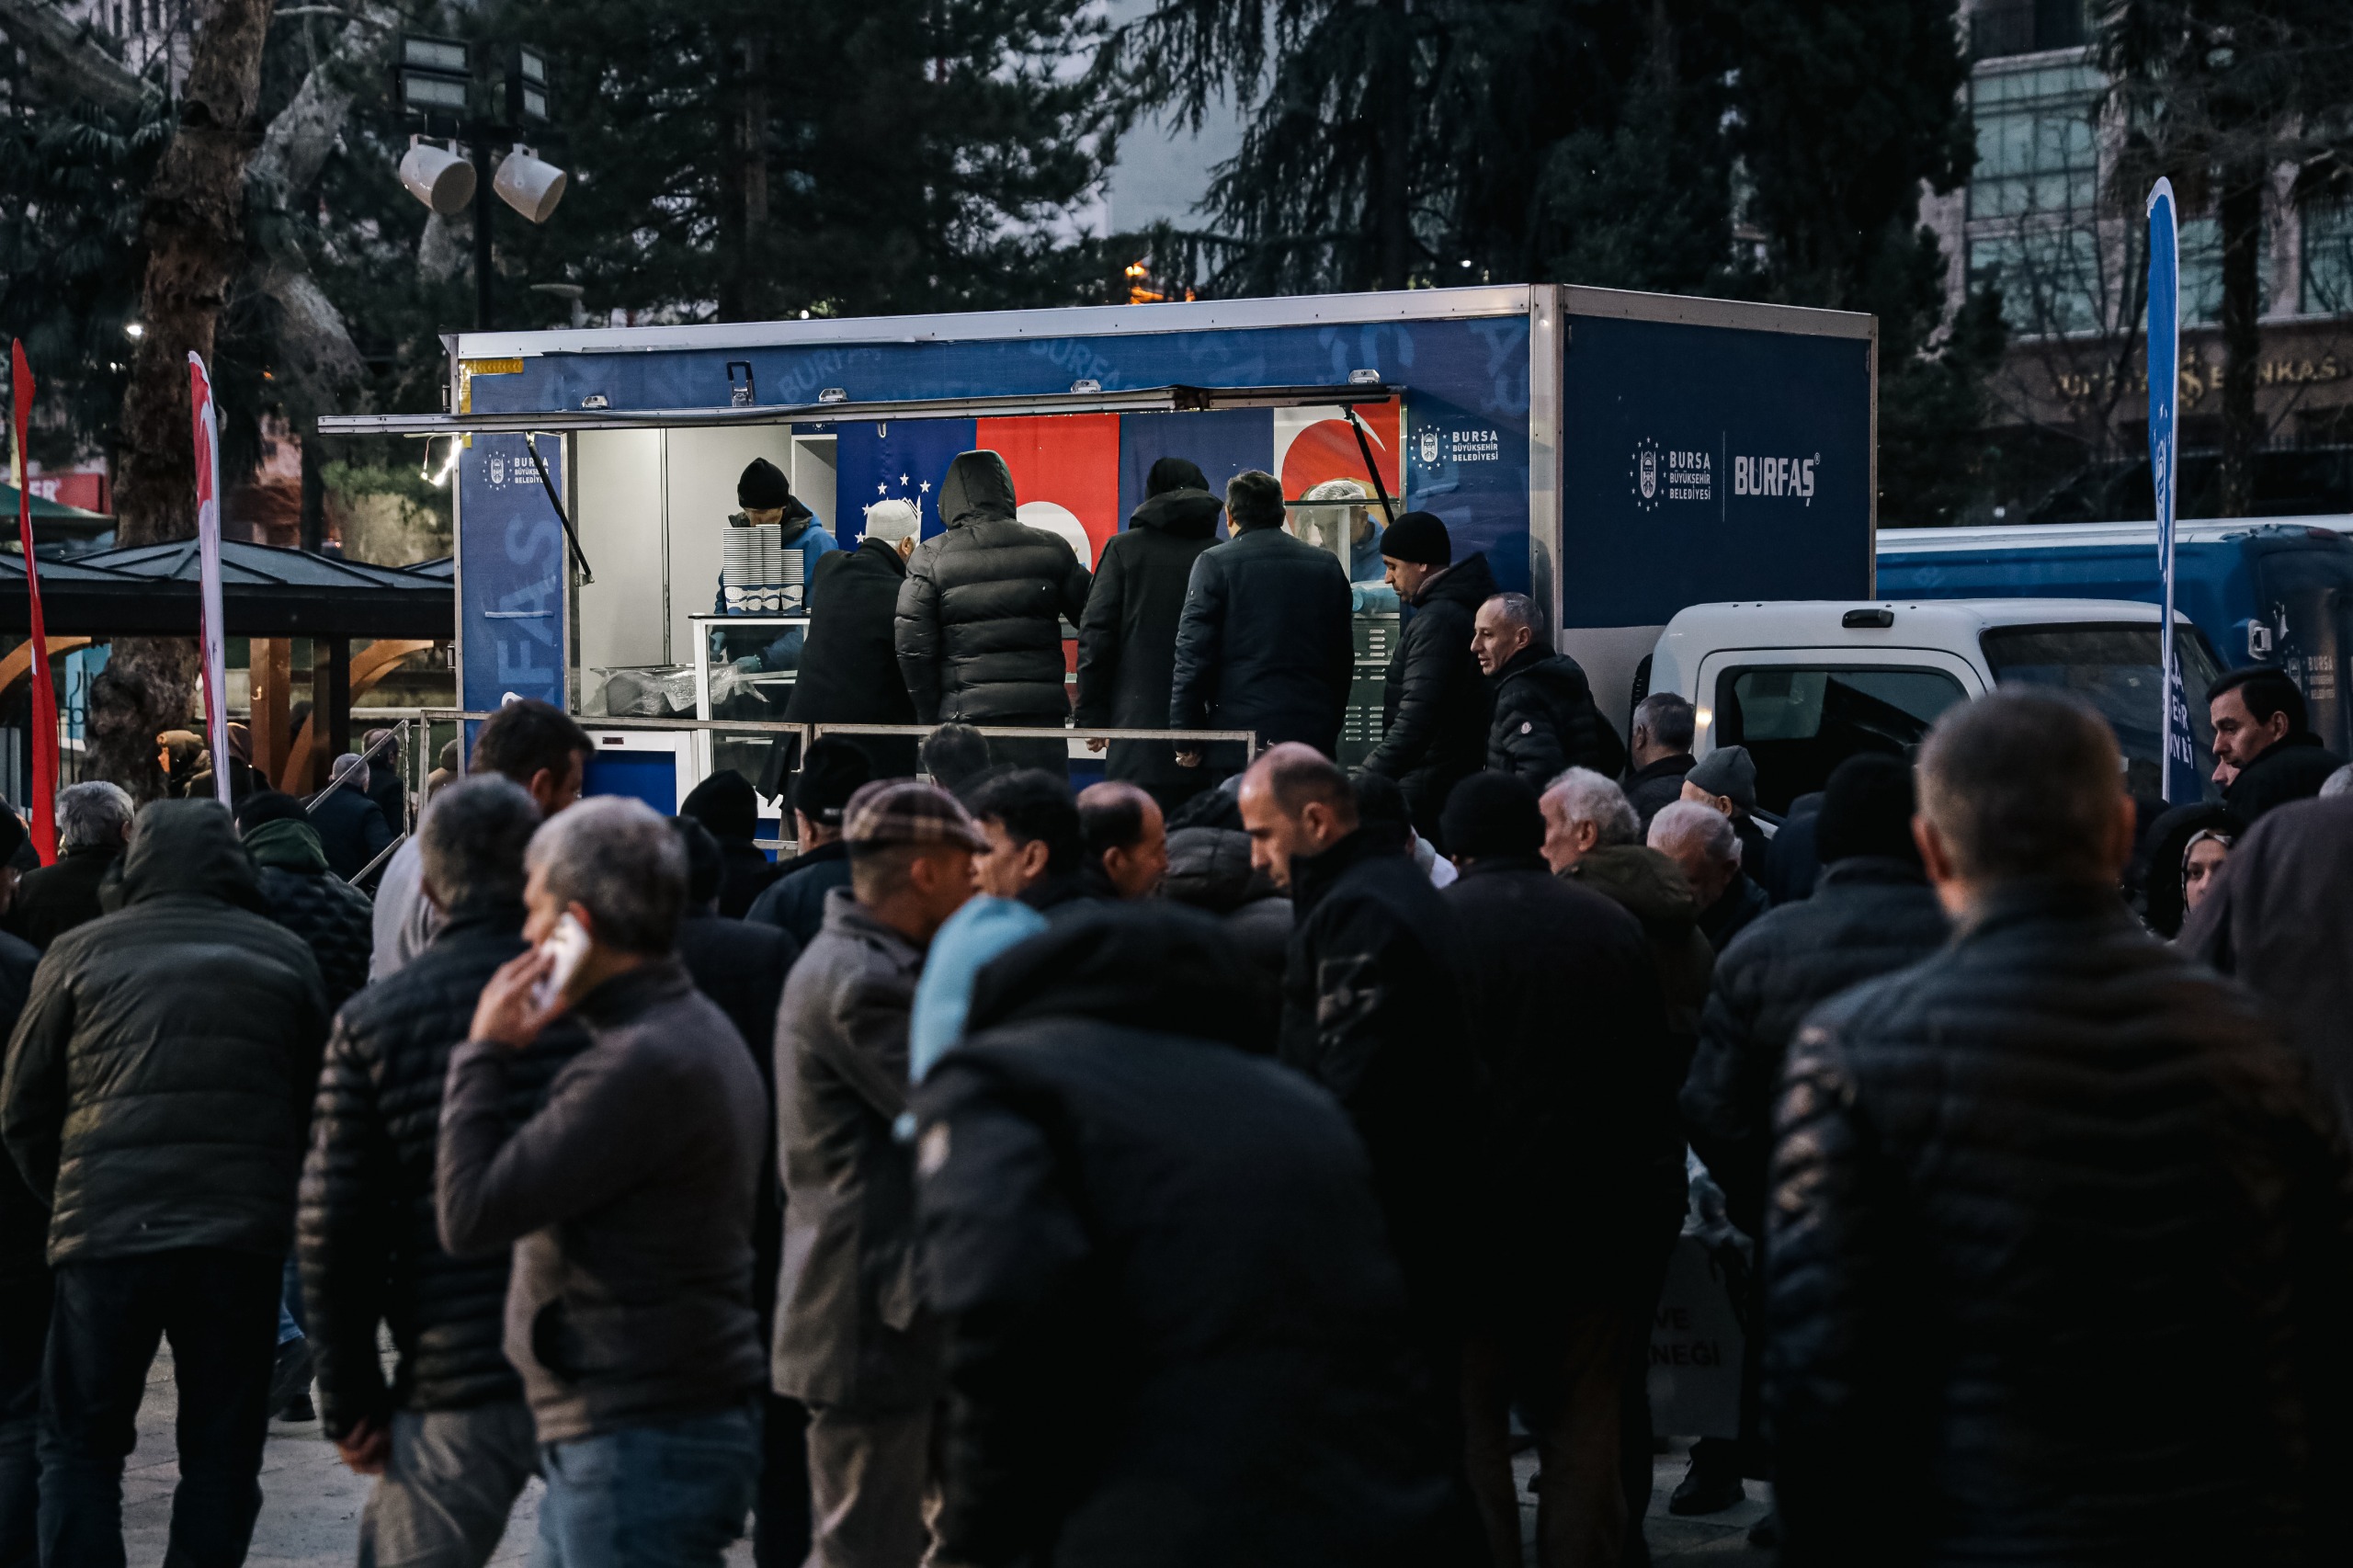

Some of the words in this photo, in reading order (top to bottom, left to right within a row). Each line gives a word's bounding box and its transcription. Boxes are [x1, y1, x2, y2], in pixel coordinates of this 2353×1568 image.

[1452, 430, 1498, 443] BURSA
[514, 456, 549, 467] BURA
[1452, 450, 1498, 461] BELEDİYESİ
[1669, 450, 1711, 470] BURSA
[1669, 484, 1711, 500] BELEDİYESİ
